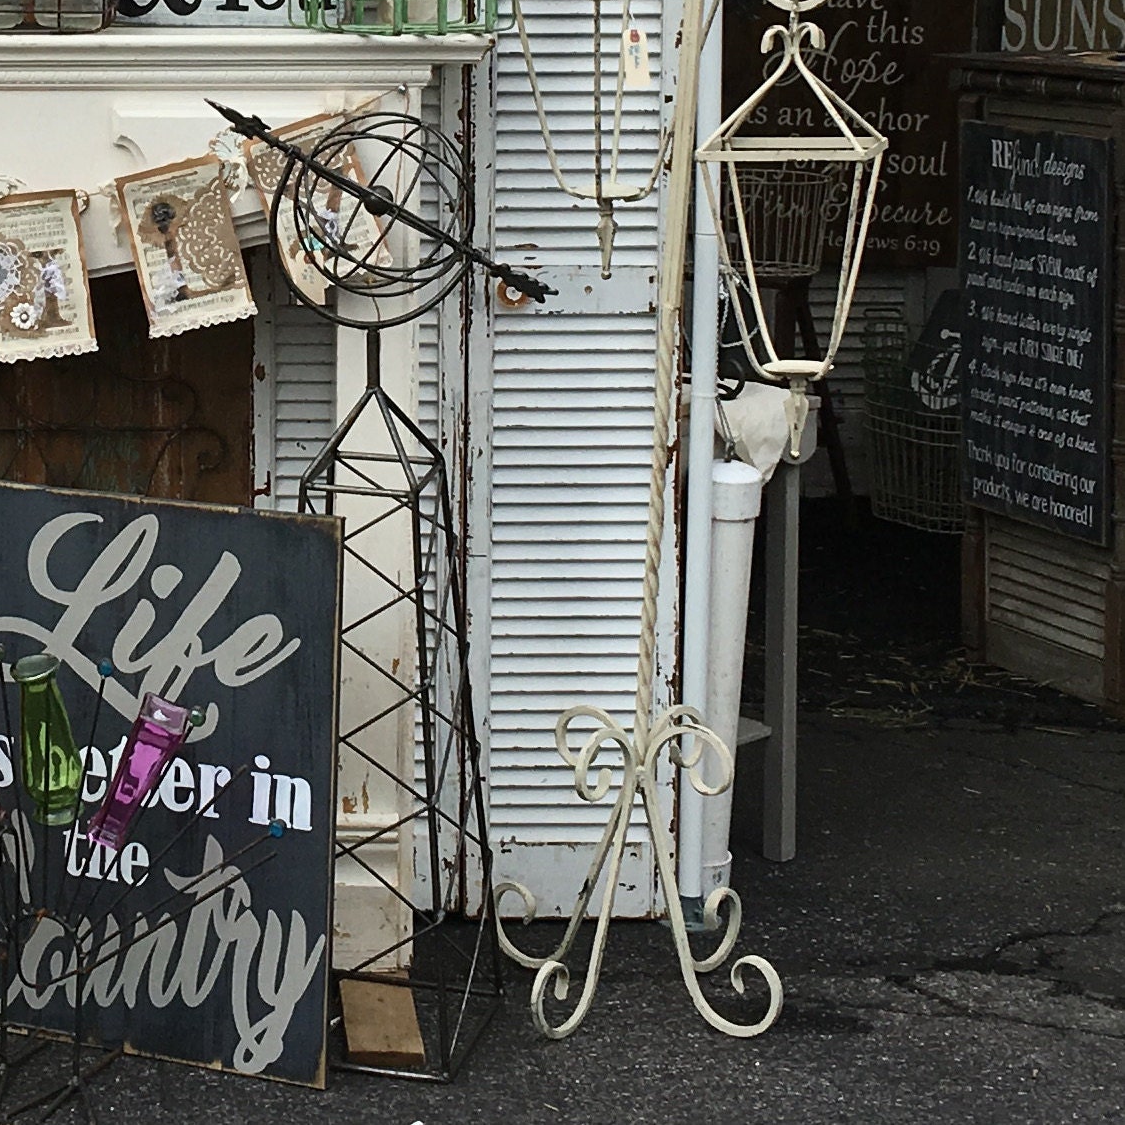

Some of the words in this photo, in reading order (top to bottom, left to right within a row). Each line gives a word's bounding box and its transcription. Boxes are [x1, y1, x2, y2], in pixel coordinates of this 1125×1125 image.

[866, 10, 925, 45] this
[777, 106, 814, 127] an
[885, 141, 948, 177] soul
[1043, 152, 1086, 186] designs
[904, 234, 941, 257] 6:19
[967, 439, 993, 466] Thank
[994, 452, 1010, 473] you
[1012, 452, 1027, 475] for
[1028, 463, 1079, 496] considering
[1079, 476, 1097, 495] our
[972, 475, 1013, 505] products,
[1014, 489, 1030, 509] we
[1031, 493, 1048, 513] are
[249, 754, 314, 832] in
